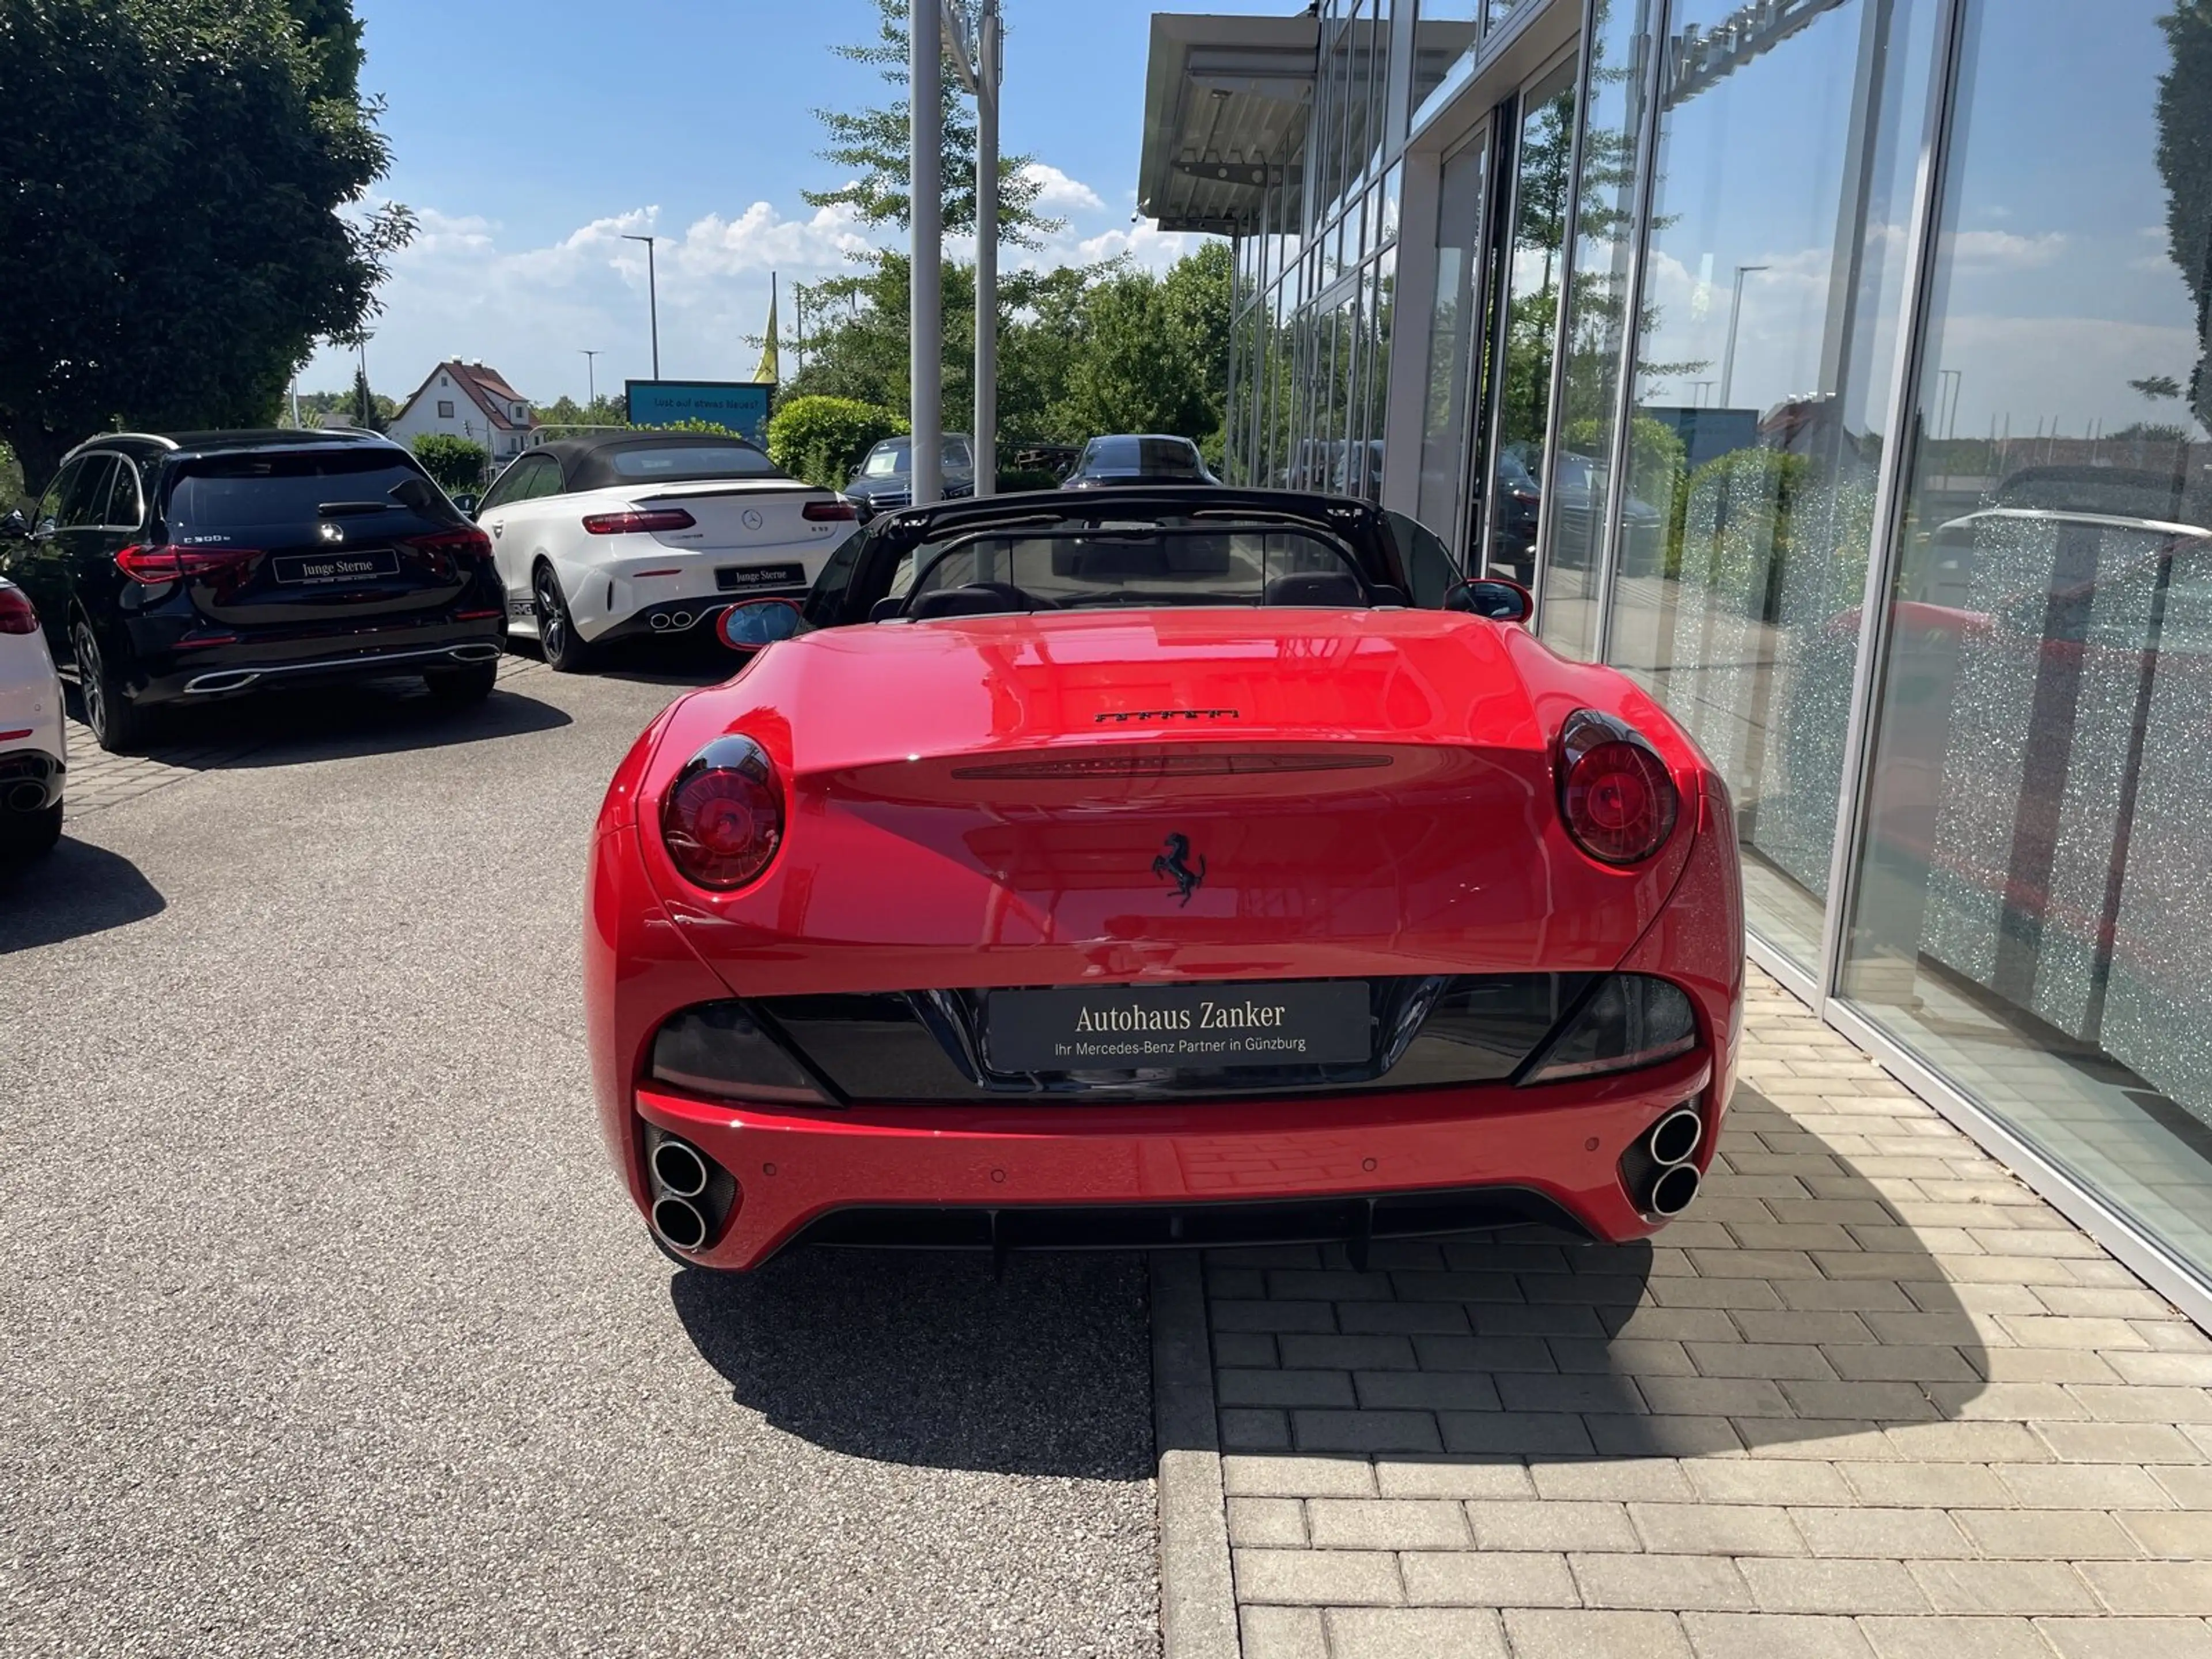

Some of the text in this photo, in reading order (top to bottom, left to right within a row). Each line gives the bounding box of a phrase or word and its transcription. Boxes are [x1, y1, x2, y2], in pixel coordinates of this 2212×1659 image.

[654, 399, 674, 408] Lust
[694, 399, 724, 408] etwas
[302, 560, 373, 577] Junge Sterne
[736, 570, 787, 584] Junge Sterne
[1075, 1001, 1285, 1032] Autohaus Zanker
[1055, 1036, 1306, 1056] Ihr Mercedes-Benz Partner in Günzburg
